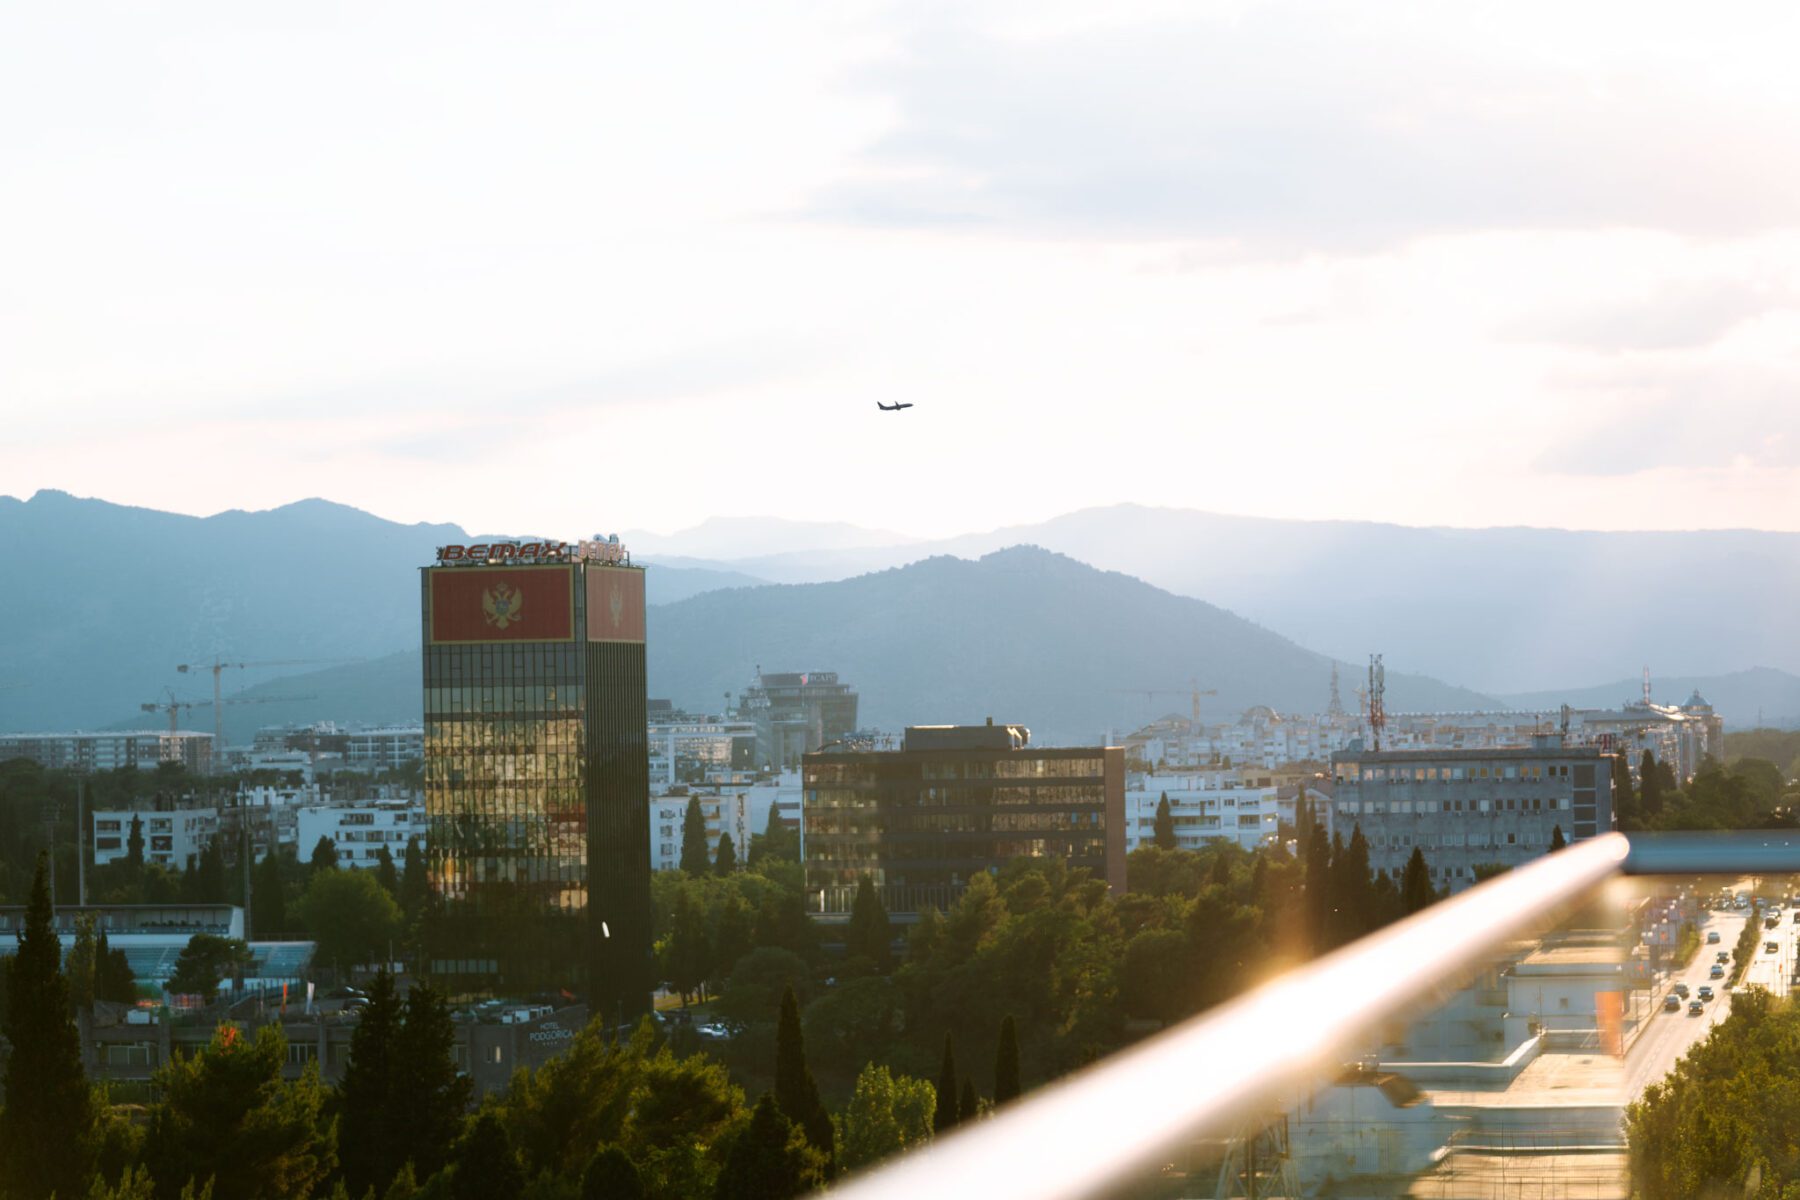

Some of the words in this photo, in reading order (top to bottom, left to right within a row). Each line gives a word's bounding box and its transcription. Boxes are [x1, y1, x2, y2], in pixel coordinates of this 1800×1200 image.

[442, 541, 567, 560] BEMAX
[539, 1022, 560, 1030] HOTEL
[529, 1029, 574, 1041] PODGORICA
